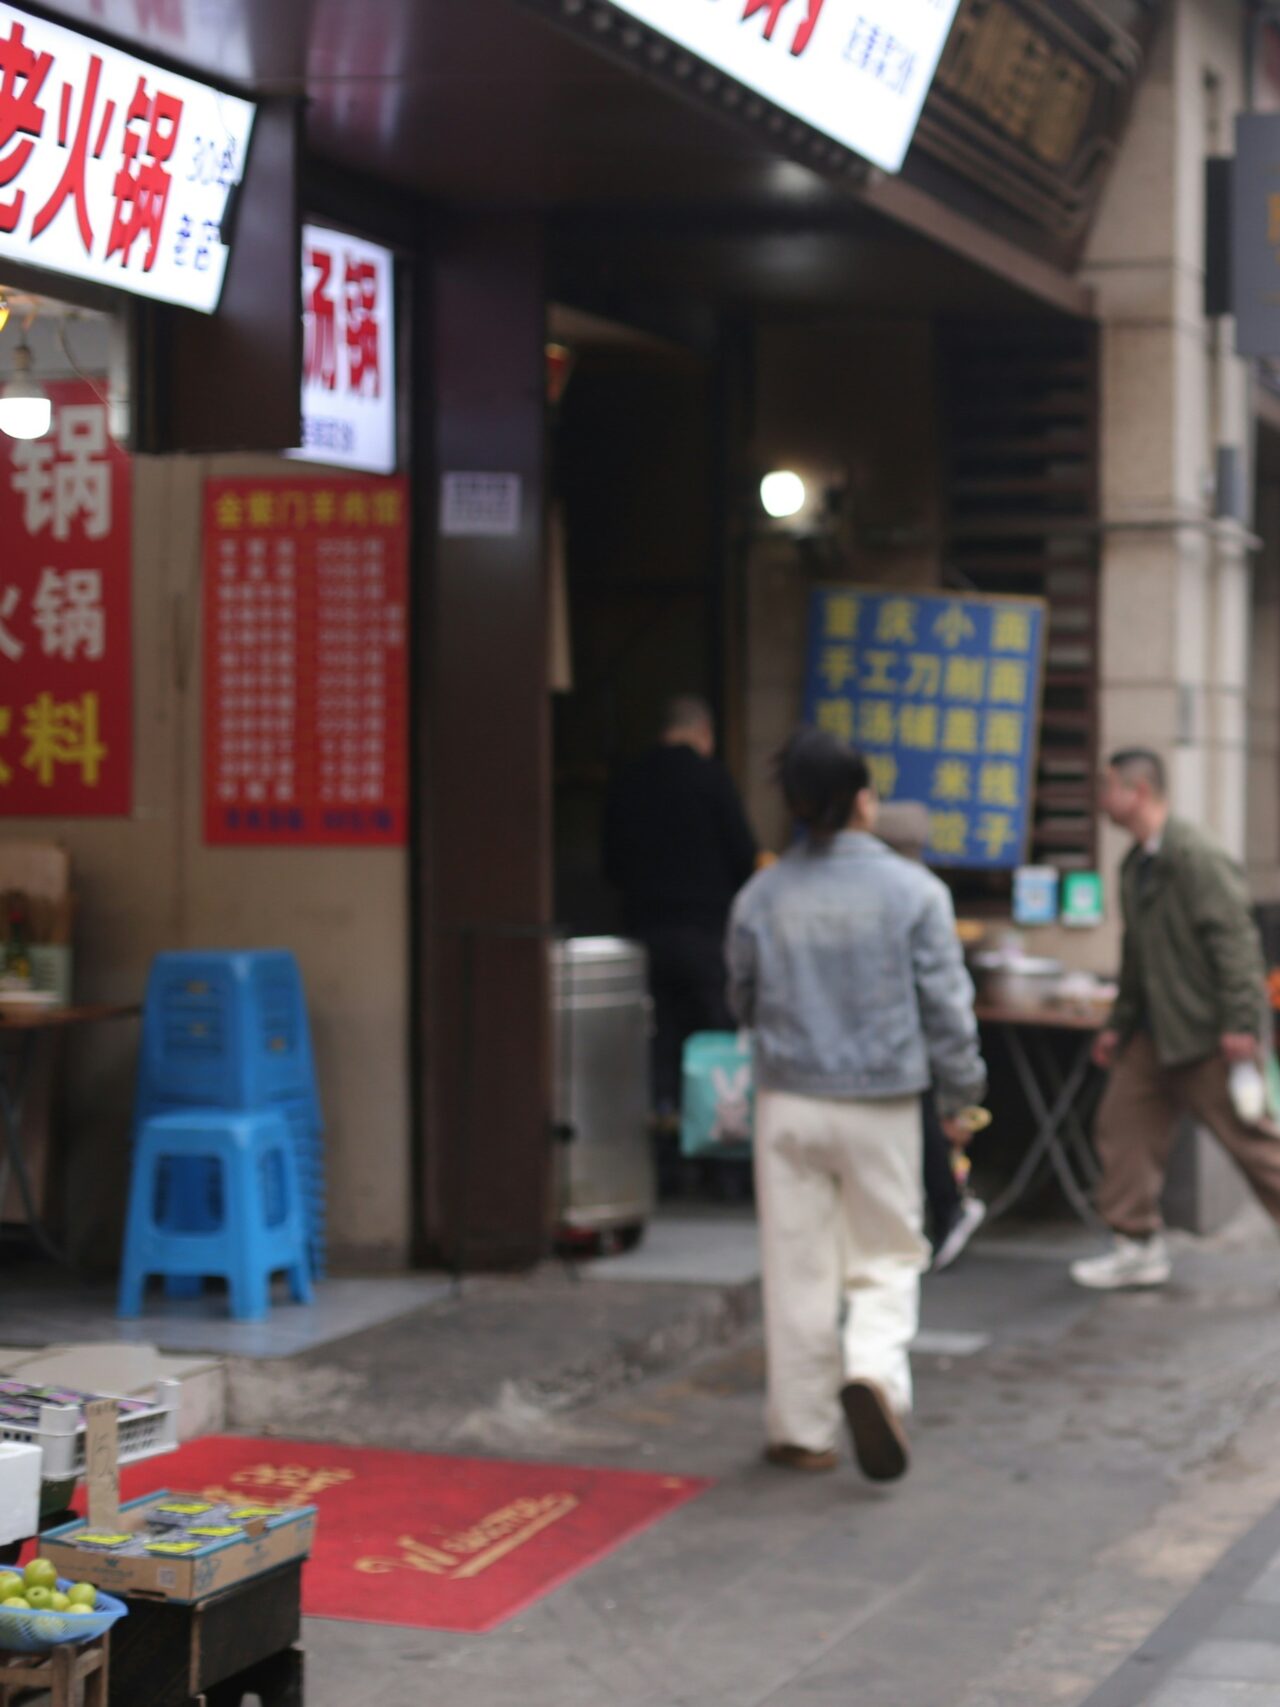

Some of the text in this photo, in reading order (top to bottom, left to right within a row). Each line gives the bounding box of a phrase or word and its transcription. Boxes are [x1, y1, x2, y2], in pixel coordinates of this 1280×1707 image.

[824, 598, 1031, 652] 重庆小面
[821, 645, 1027, 704] 手工刀削面
[933, 761, 1018, 807] 米线
